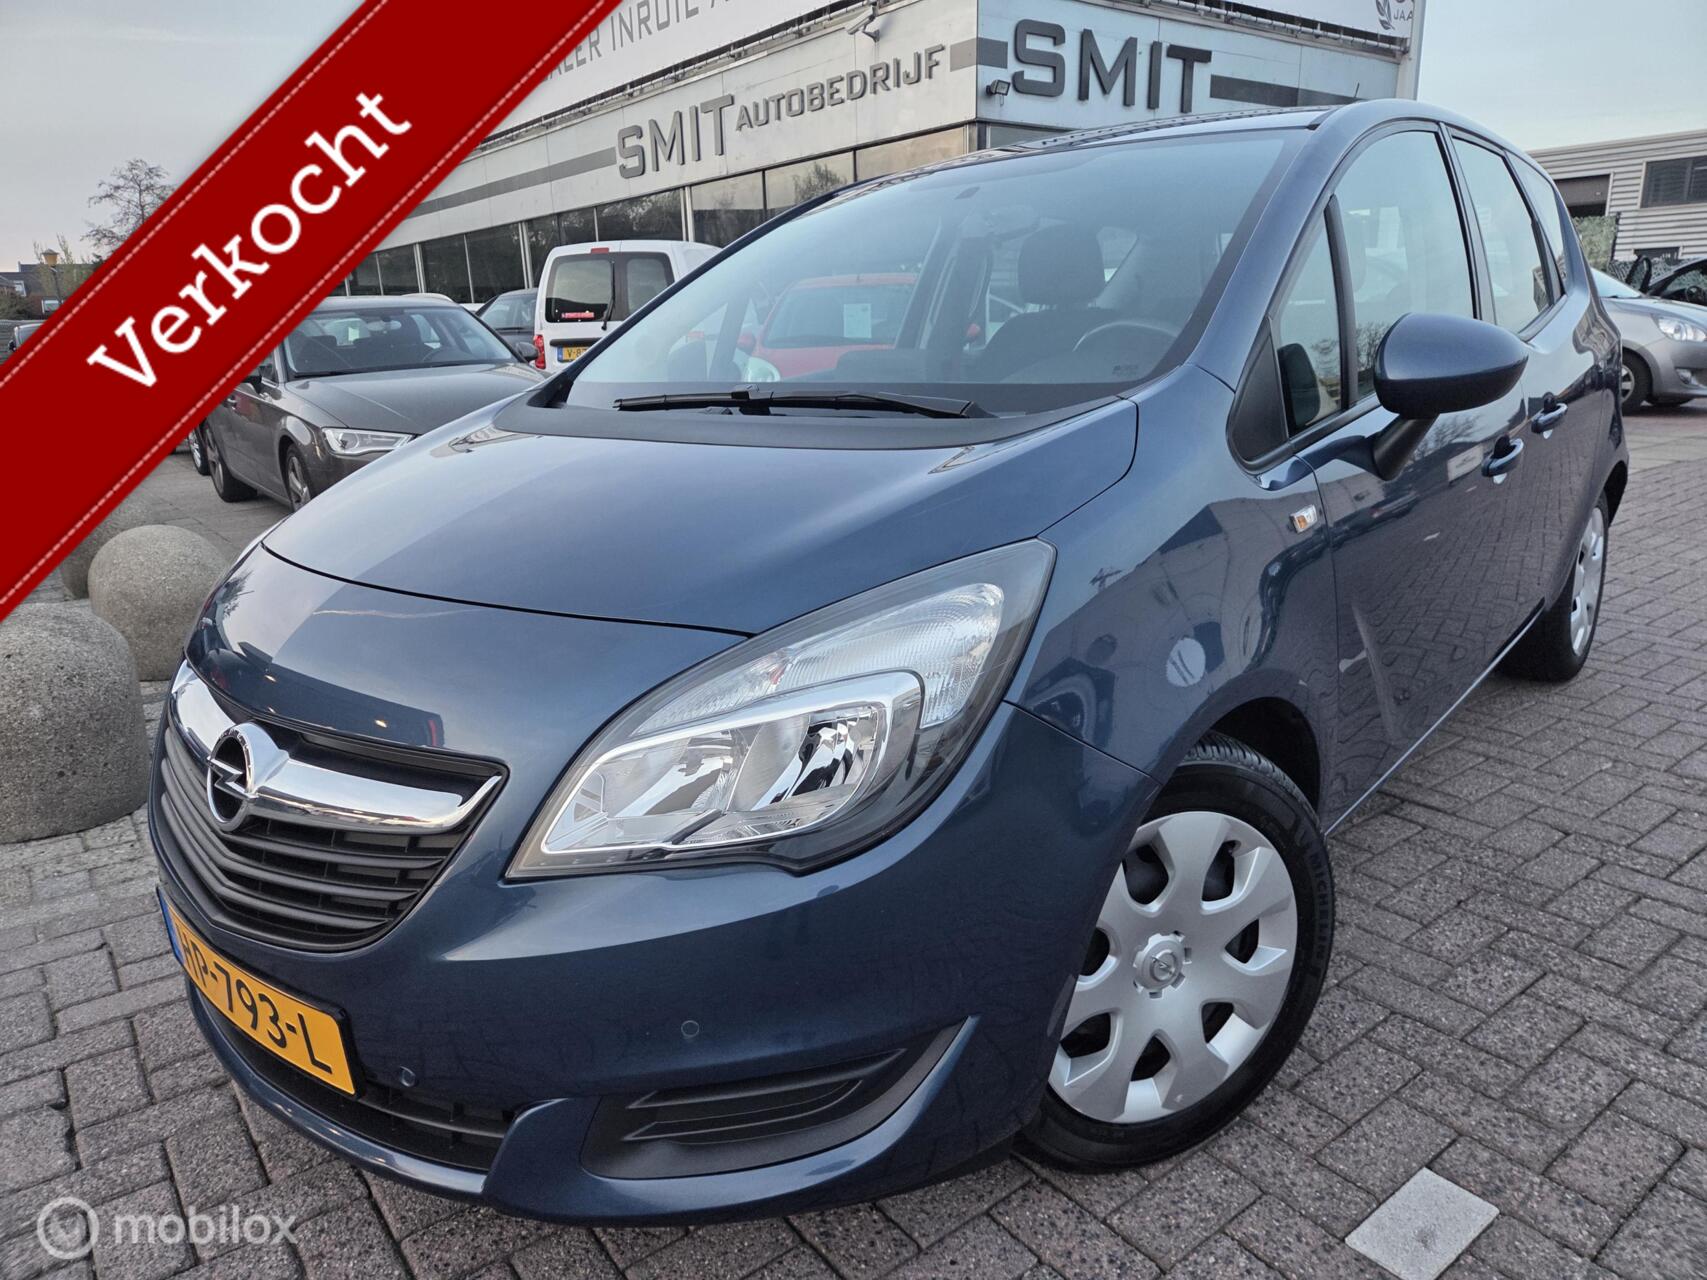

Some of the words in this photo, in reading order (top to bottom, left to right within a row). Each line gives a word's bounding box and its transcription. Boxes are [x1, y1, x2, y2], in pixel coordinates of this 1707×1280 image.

[617, 94, 734, 179] SMIT
[736, 44, 945, 131] AUTOBEDRIJF
[1012, 18, 1212, 113] SMIT
